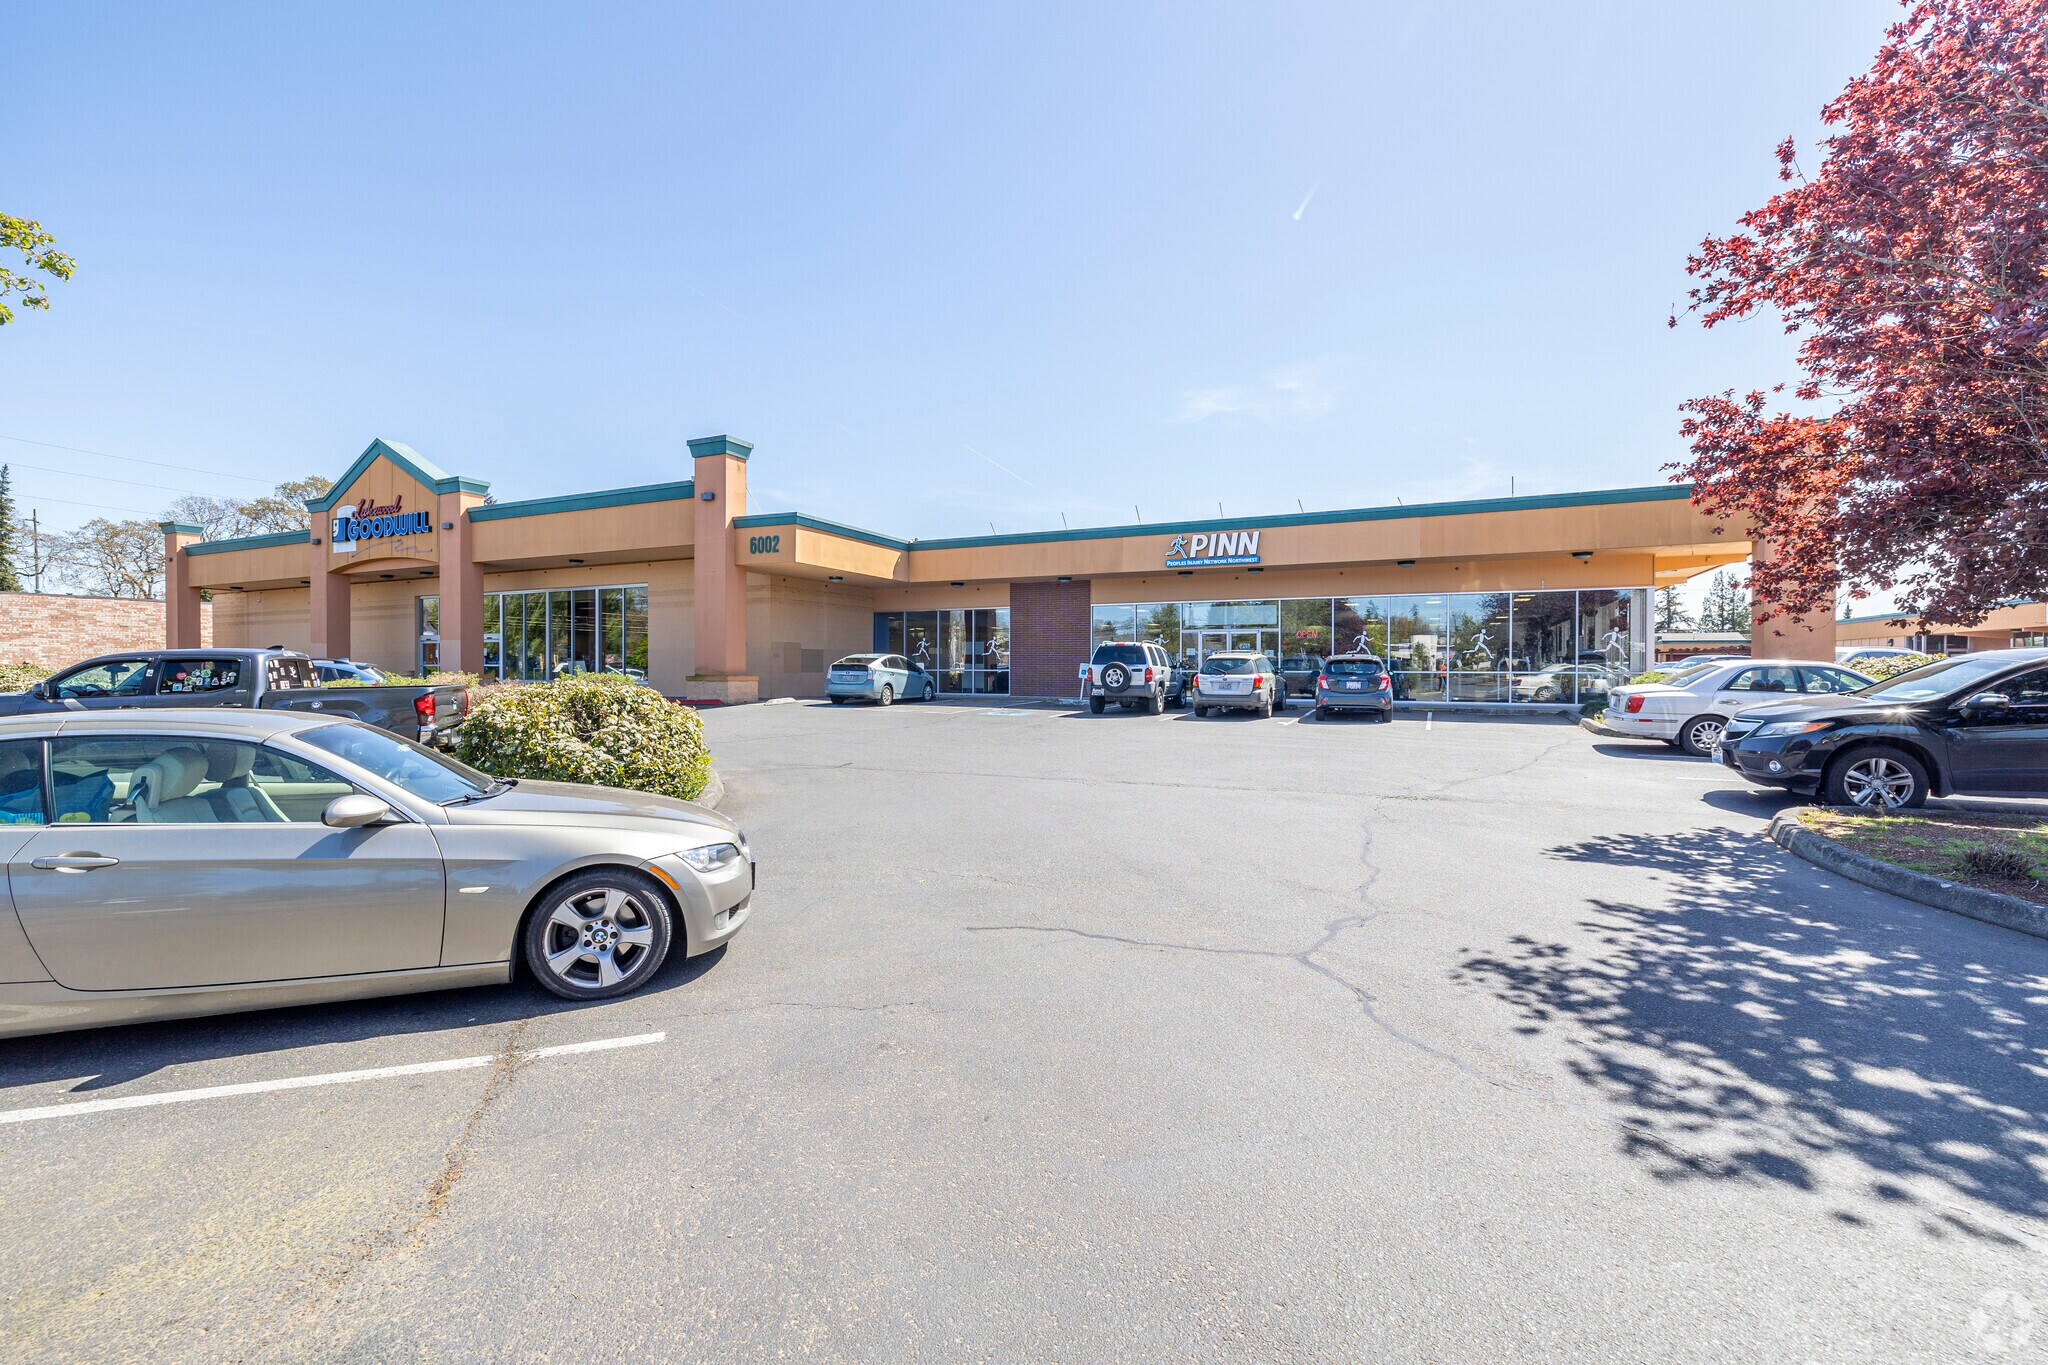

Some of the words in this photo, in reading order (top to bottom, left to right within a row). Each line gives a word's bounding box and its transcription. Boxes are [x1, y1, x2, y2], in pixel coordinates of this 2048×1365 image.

[351, 495, 402, 520] Lakewood
[347, 511, 431, 541] GOODWILL
[750, 535, 779, 554] 6002
[1189, 531, 1260, 558] PINN
[1295, 629, 1319, 639] OPEN
